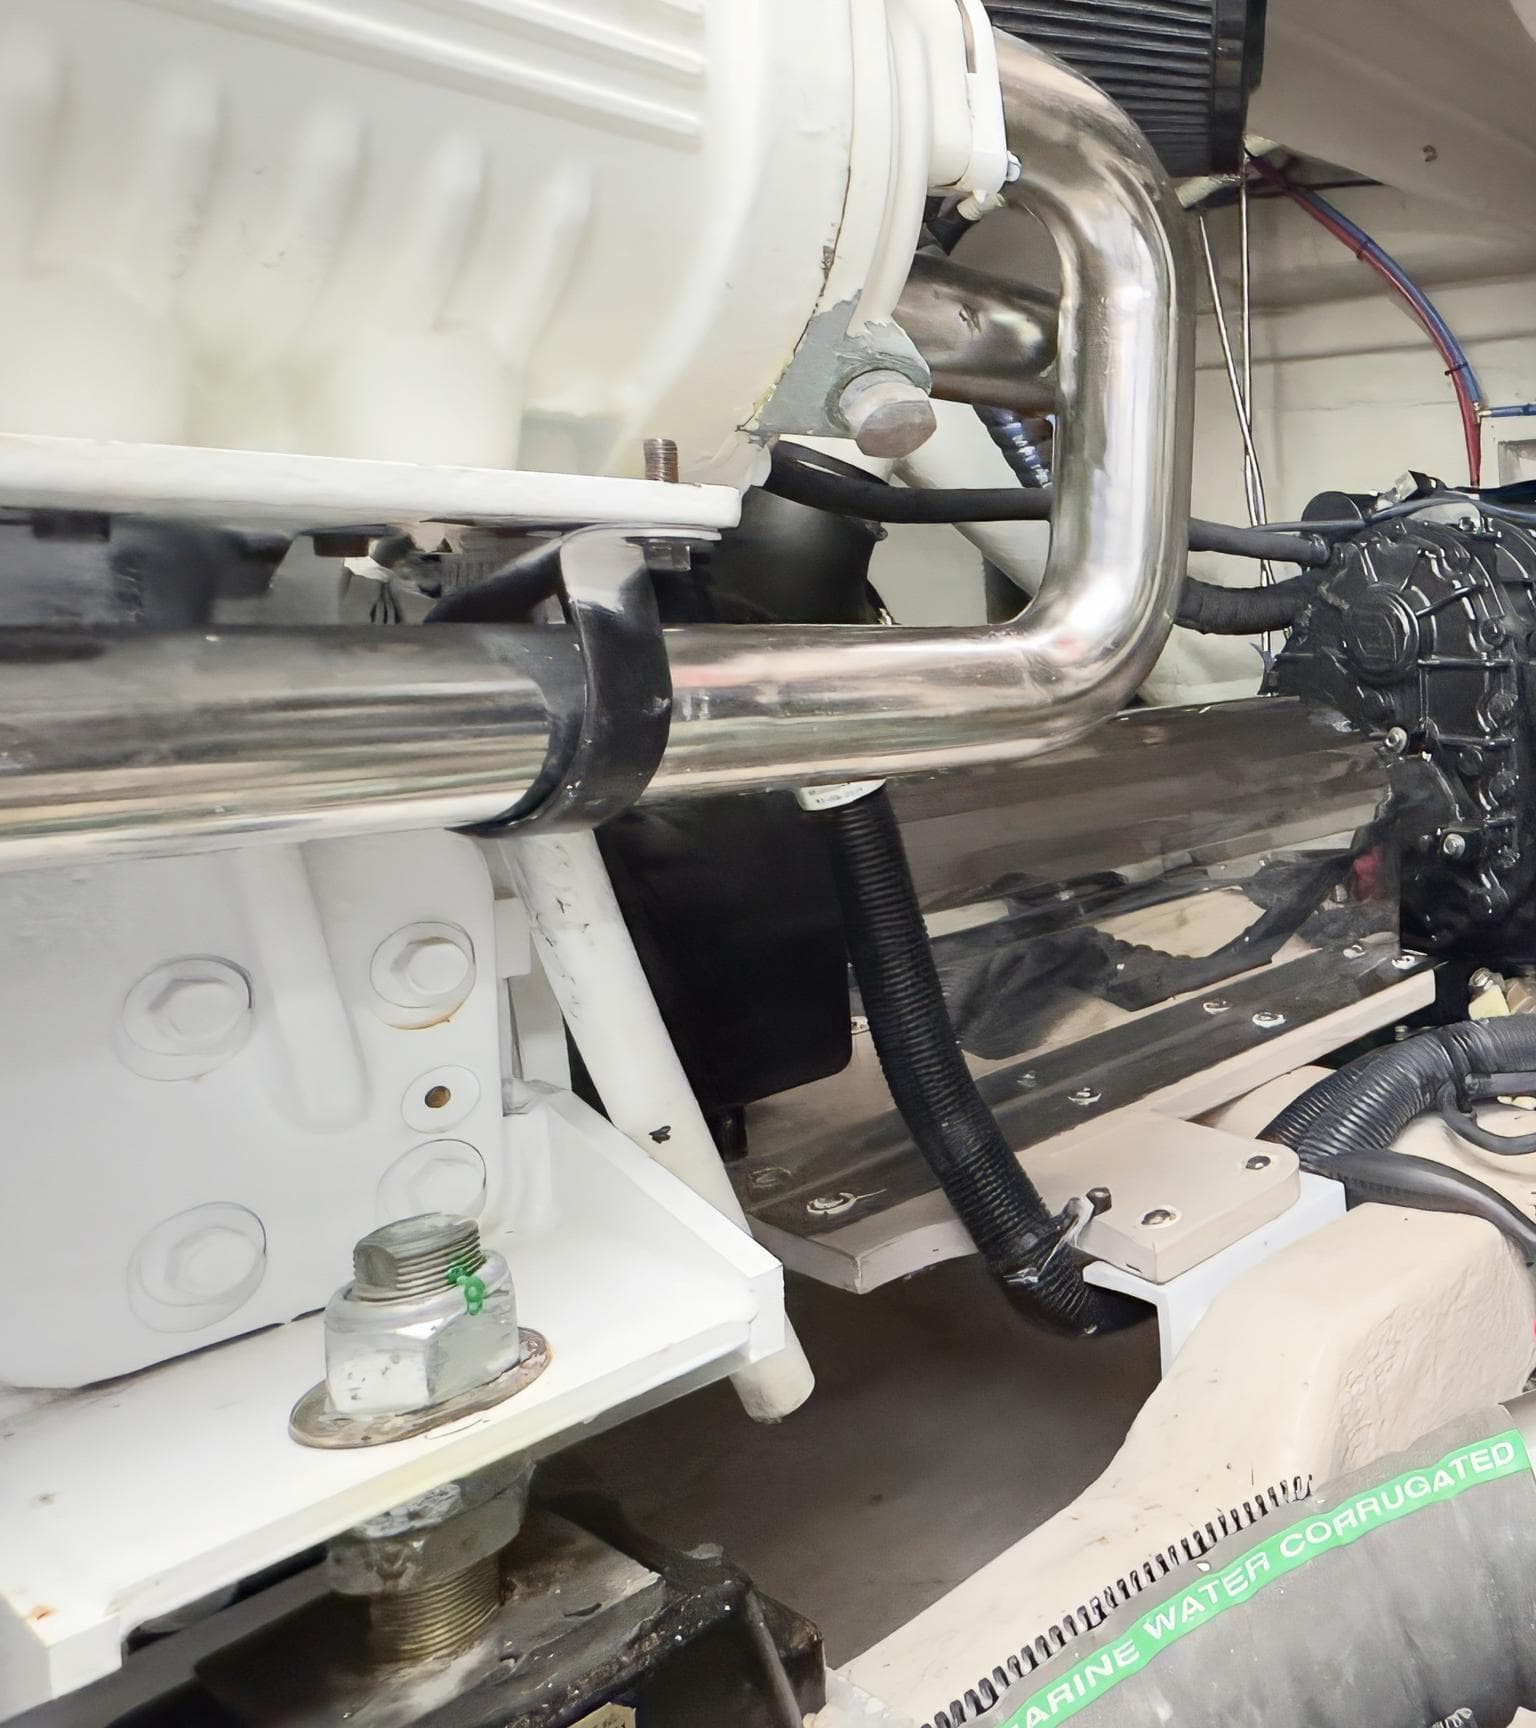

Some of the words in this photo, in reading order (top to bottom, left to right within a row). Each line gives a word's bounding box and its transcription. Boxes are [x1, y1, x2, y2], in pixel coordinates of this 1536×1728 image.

[1011, 1639, 1141, 1728] ARINE
[1142, 1552, 1270, 1639] WATER
[1279, 1441, 1515, 1558] CORRUGATED
